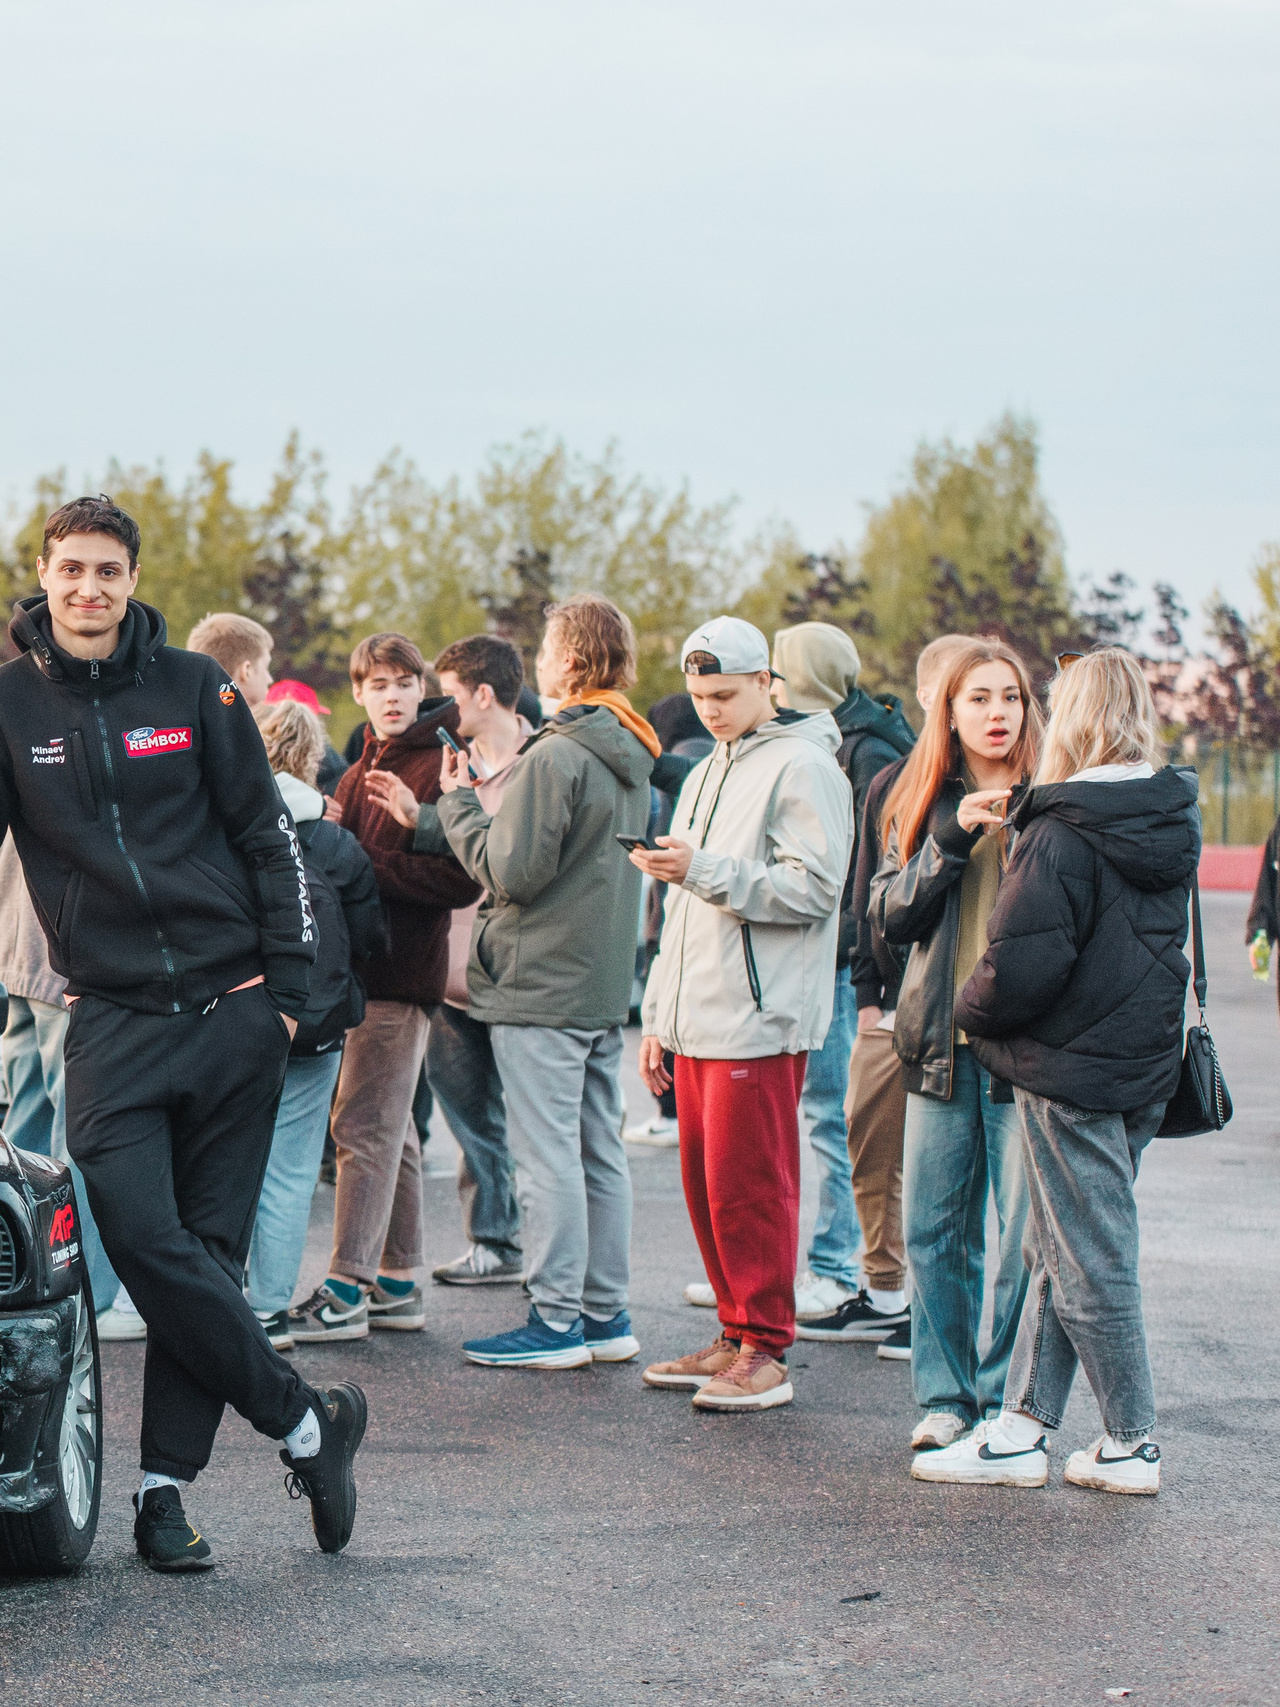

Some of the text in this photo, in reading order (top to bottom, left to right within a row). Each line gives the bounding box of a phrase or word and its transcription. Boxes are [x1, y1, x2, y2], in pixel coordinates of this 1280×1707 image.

[128, 731, 189, 751] REMBOX
[31, 746, 64, 755] Minaev
[32, 755, 66, 764] Andrey
[51, 1246, 70, 1265] TUNING
